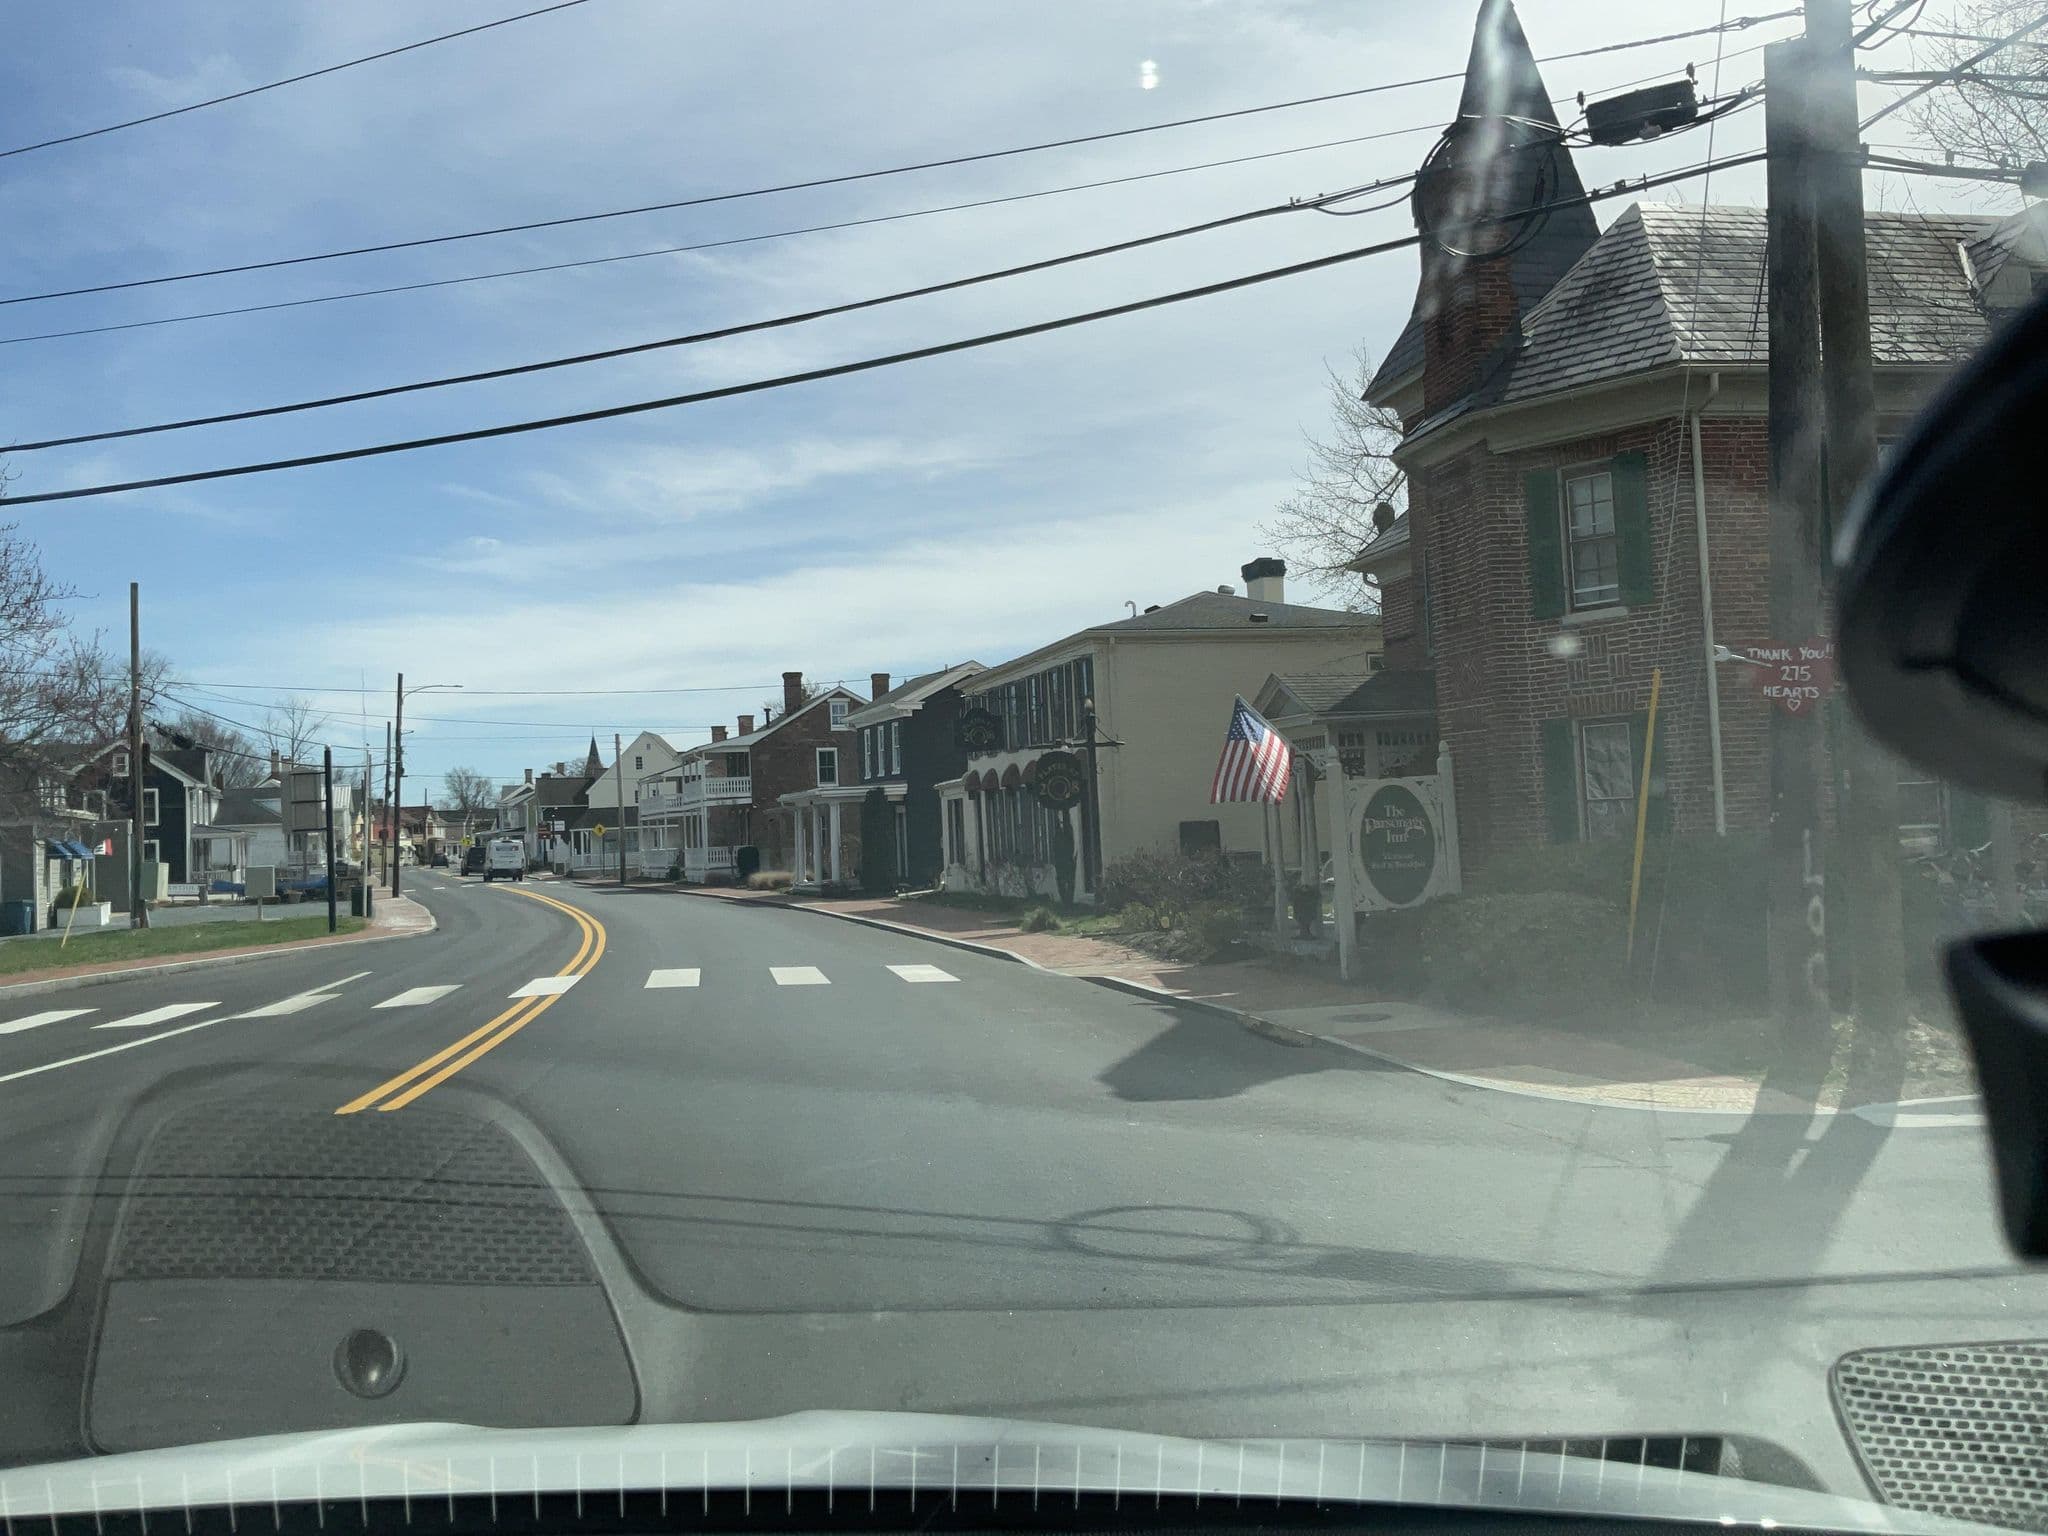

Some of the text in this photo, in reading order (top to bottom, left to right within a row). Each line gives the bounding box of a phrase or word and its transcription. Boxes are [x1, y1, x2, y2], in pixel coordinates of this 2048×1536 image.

[1747, 648, 1792, 661] THANK
[1780, 665, 1812, 682] 275
[1763, 685, 1820, 699] HEARTS
[1383, 804, 1406, 817] The
[1364, 817, 1427, 836] Parsonage
[1386, 829, 1407, 843] Inn
